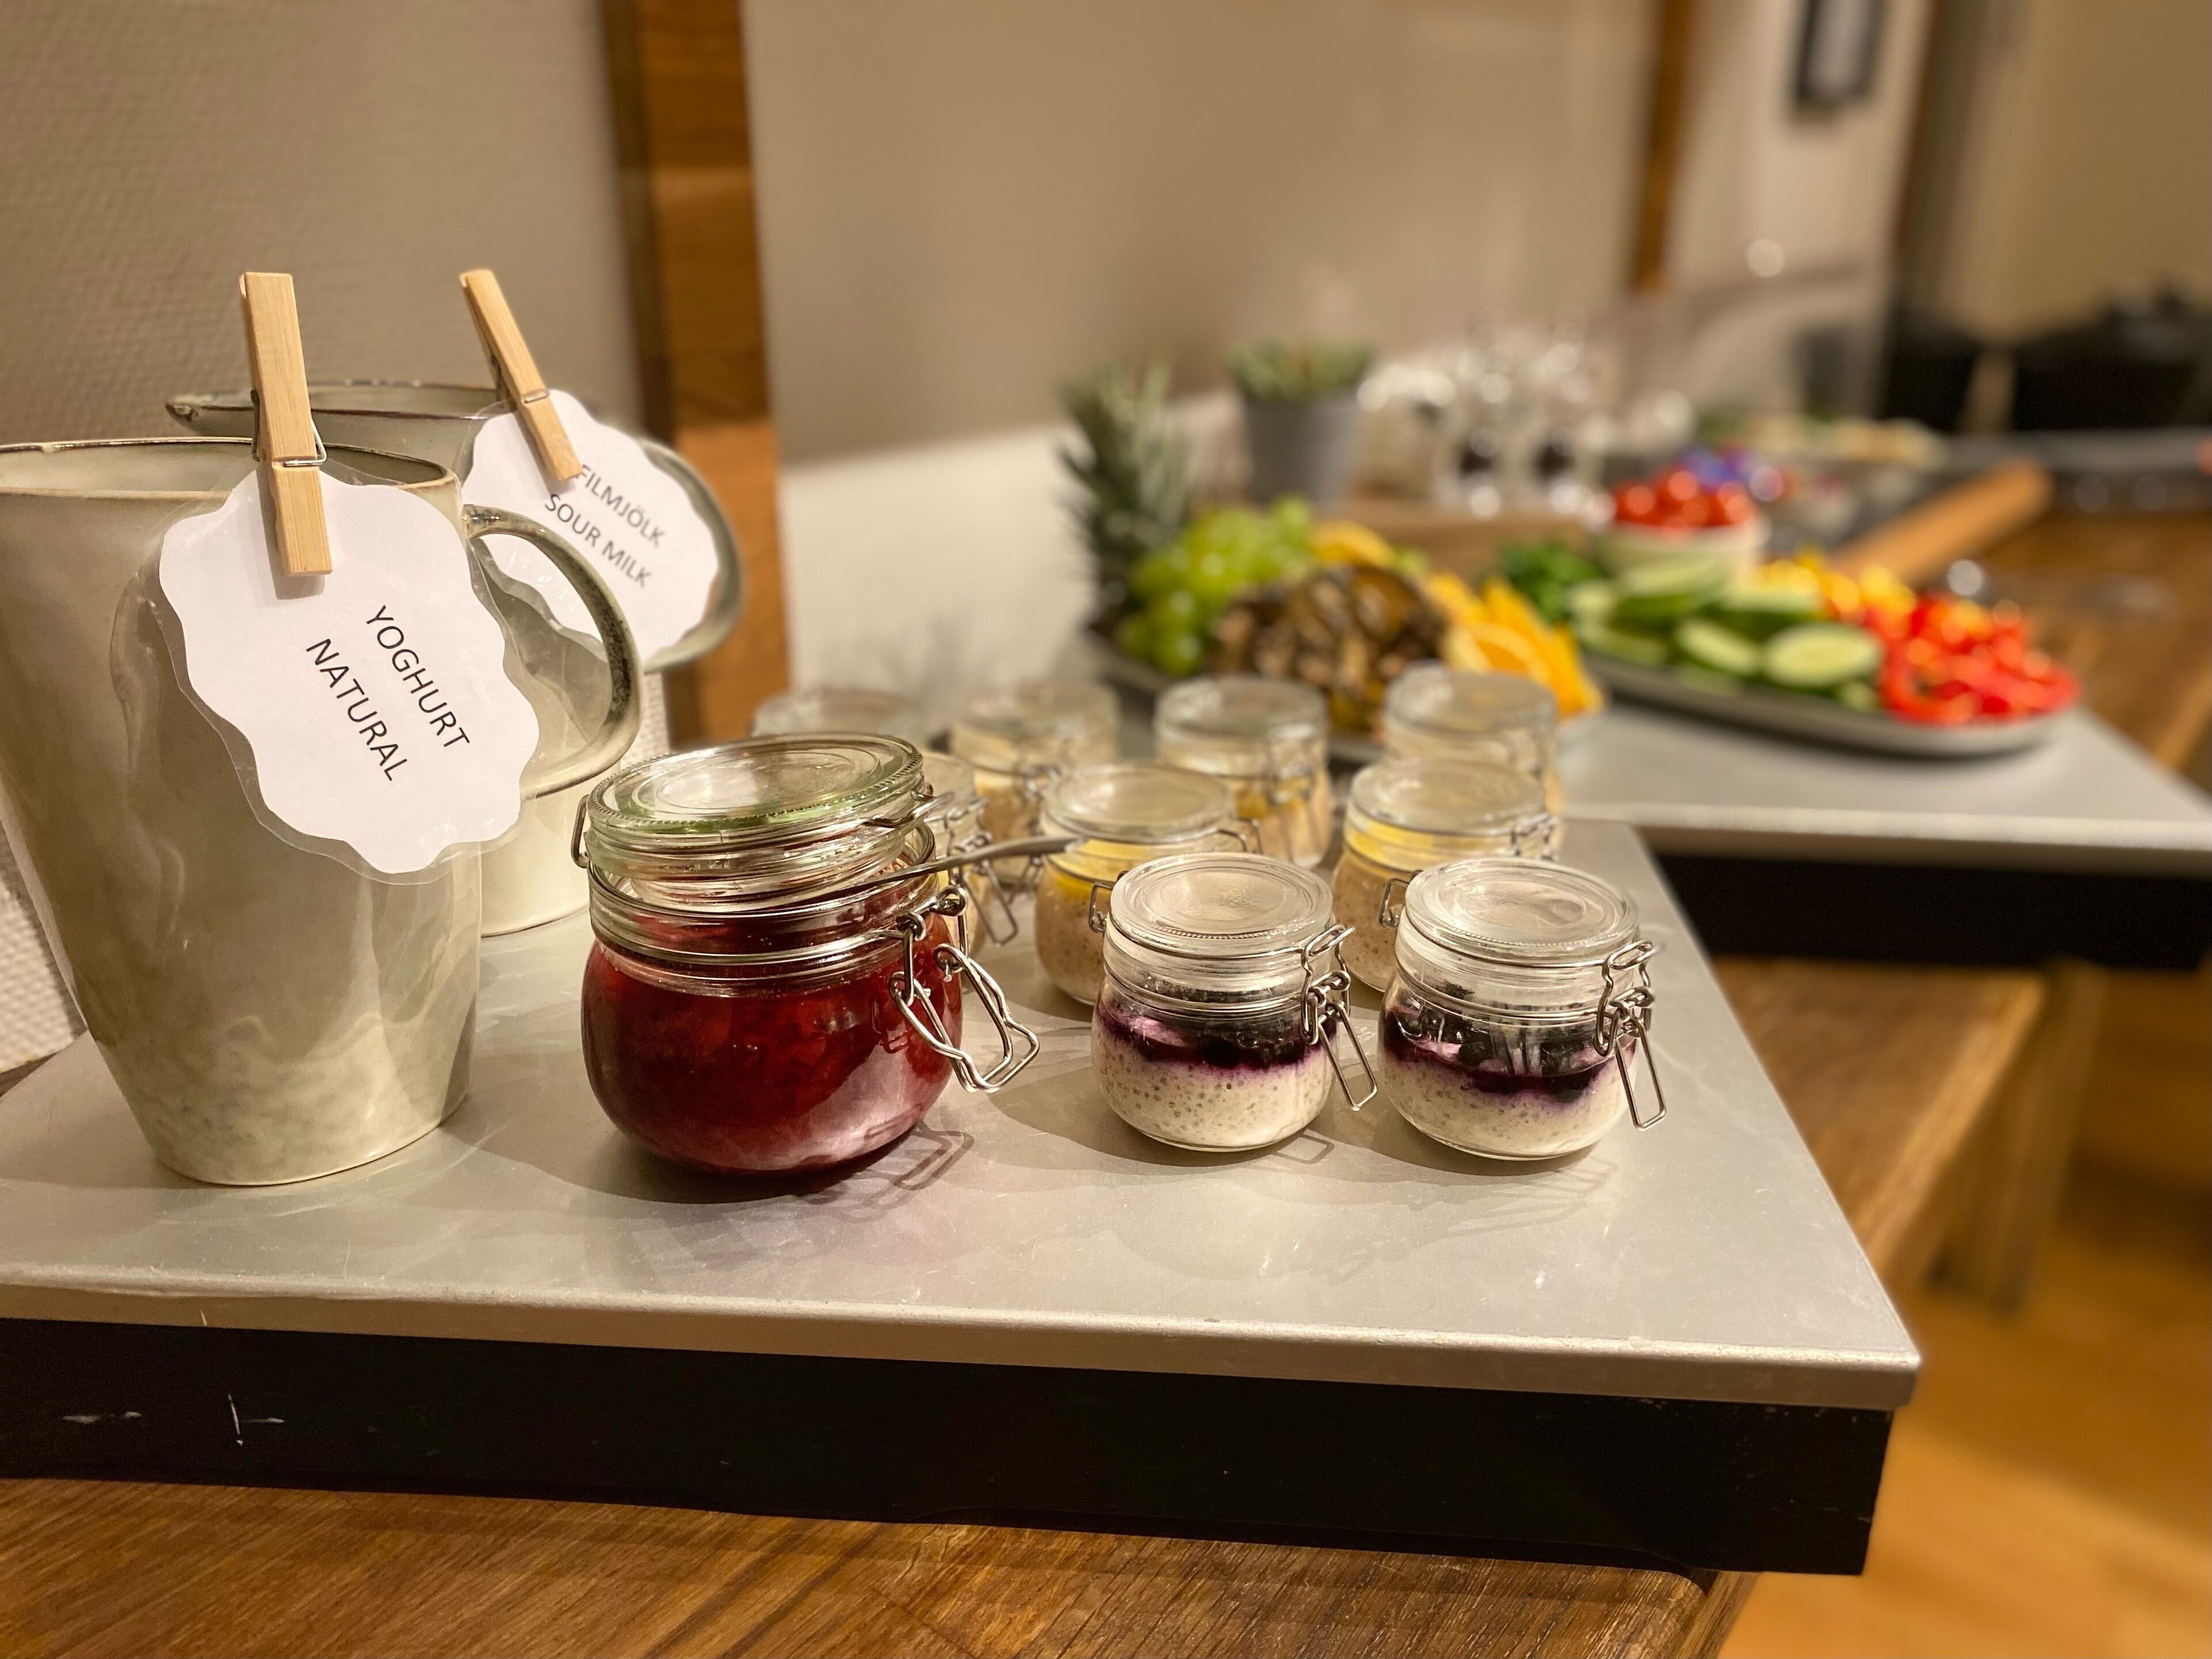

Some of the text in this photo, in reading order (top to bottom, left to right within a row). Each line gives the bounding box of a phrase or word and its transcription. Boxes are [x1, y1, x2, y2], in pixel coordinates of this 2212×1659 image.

[544, 493, 652, 589] SOUR MILK
[575, 464, 665, 547] FILMJÖLK
[306, 638, 407, 781] NATURAL
[366, 605, 470, 747] YOGHURT
